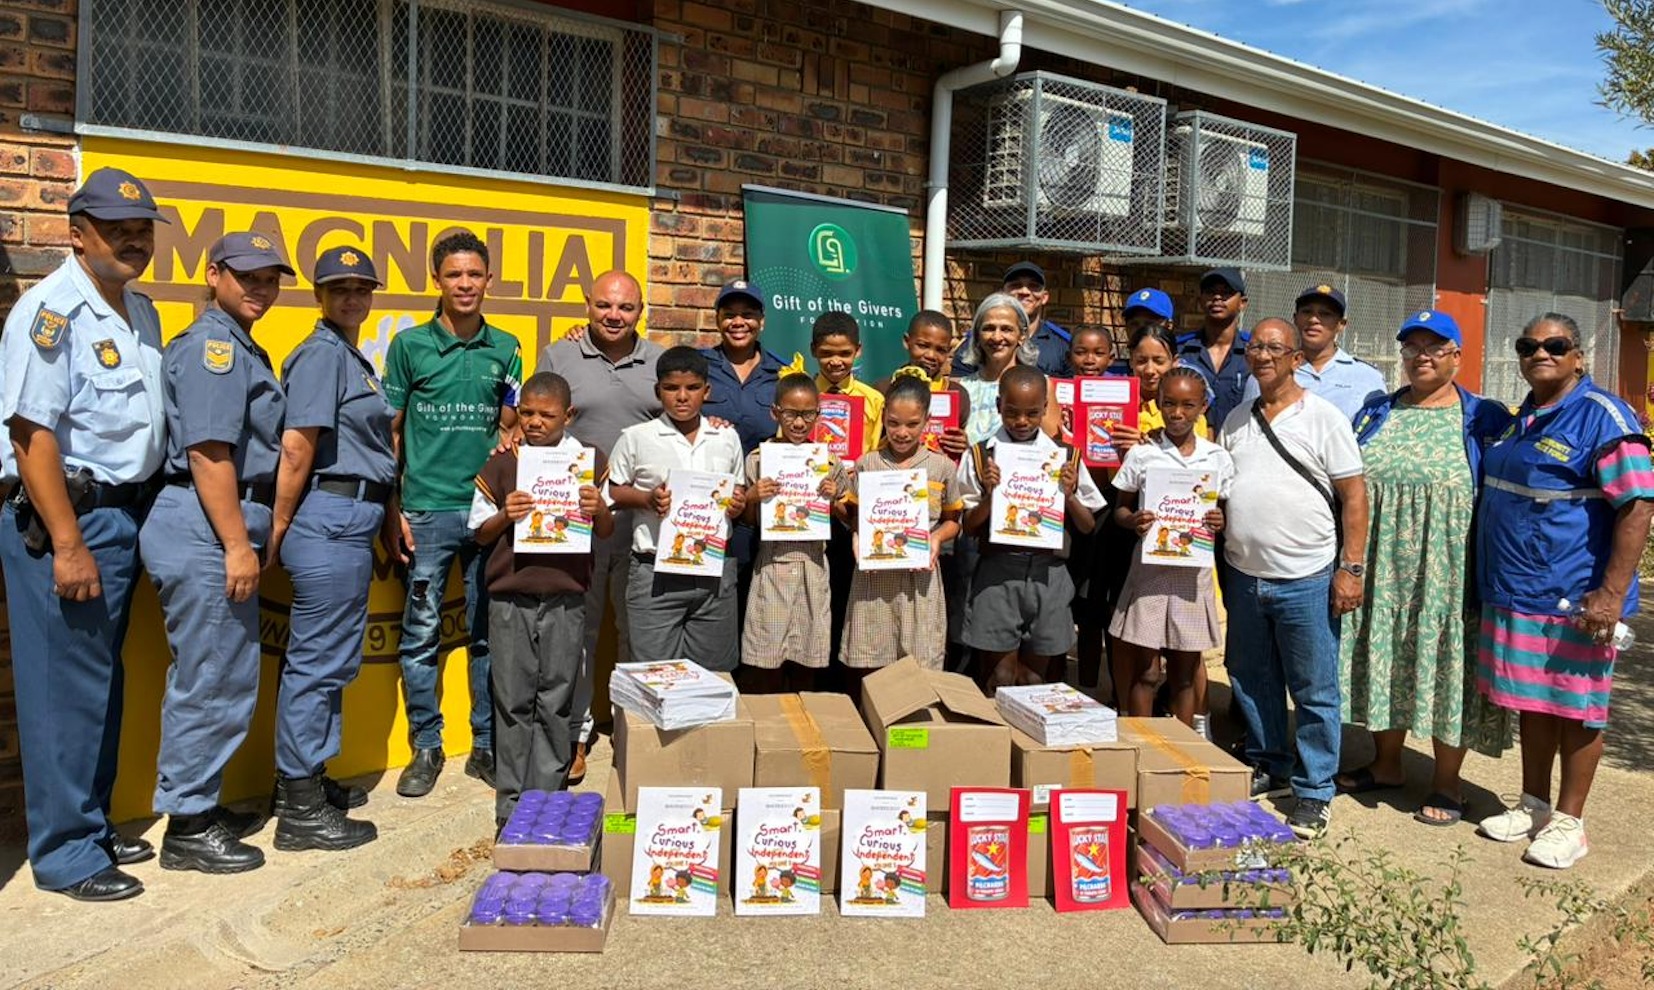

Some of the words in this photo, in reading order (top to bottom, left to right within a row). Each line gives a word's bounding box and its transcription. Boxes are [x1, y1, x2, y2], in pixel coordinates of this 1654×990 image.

[152, 204, 597, 300] MAGNLIA
[773, 294, 801, 311] Gift
[808, 297, 822, 312] of
[828, 299, 851, 314] the
[858, 300, 902, 318] Givers
[41, 311, 65, 326] POLICE
[207, 341, 231, 350] POLICE
[416, 402, 435, 413] Gift
[438, 402, 451, 413] of
[456, 402, 475, 413] the
[532, 483, 571, 500] Curious
[779, 481, 809, 492] urious
[1008, 479, 1044, 496] Curious
[1003, 489, 1054, 503] Independent
[677, 506, 711, 523] Curious
[872, 504, 907, 517] Curious
[1158, 501, 1195, 518] Curious
[672, 517, 719, 532] Independent
[867, 514, 919, 526] Independent
[651, 832, 695, 850] Curious
[754, 832, 797, 850] Curious
[860, 834, 902, 852] Curious
[647, 845, 708, 860] Independent
[751, 845, 811, 860] Independent
[857, 845, 915, 863] Independent
